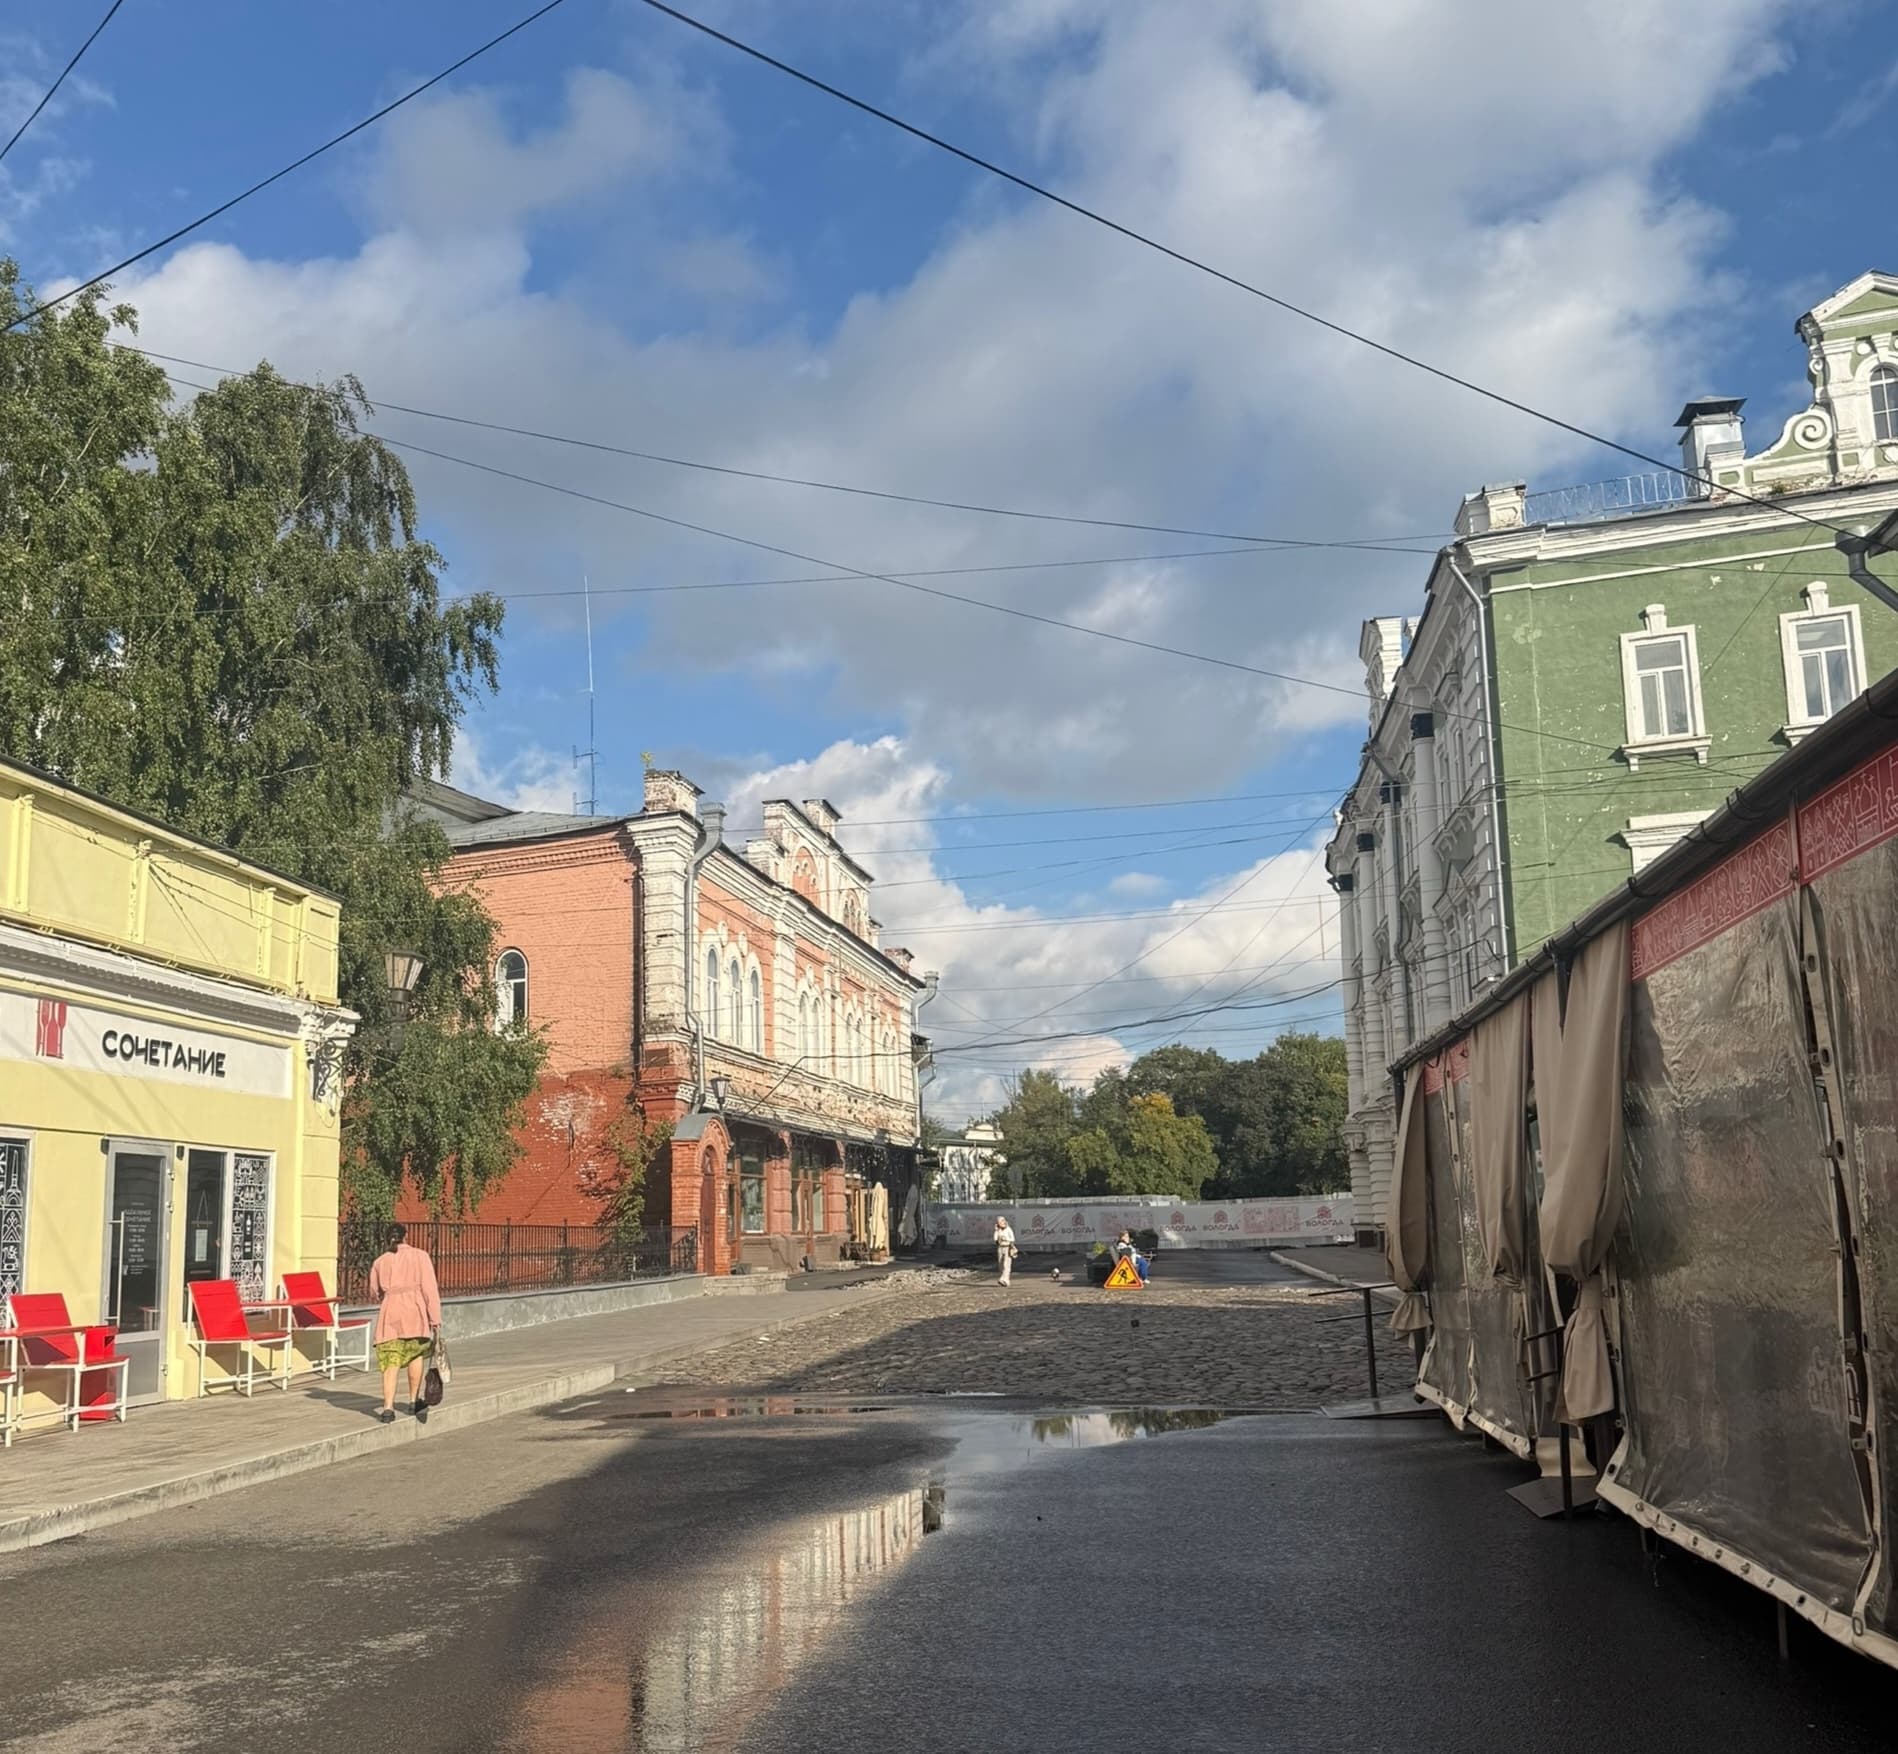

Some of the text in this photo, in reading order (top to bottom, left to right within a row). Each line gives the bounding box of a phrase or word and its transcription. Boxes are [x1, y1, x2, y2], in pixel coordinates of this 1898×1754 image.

[102, 1030, 226, 1078] СОЧЕТАНИЕ
[1203, 1223, 1240, 1232] ВОЛОГДА
[1306, 1219, 1344, 1228] ВОЛОГДА
